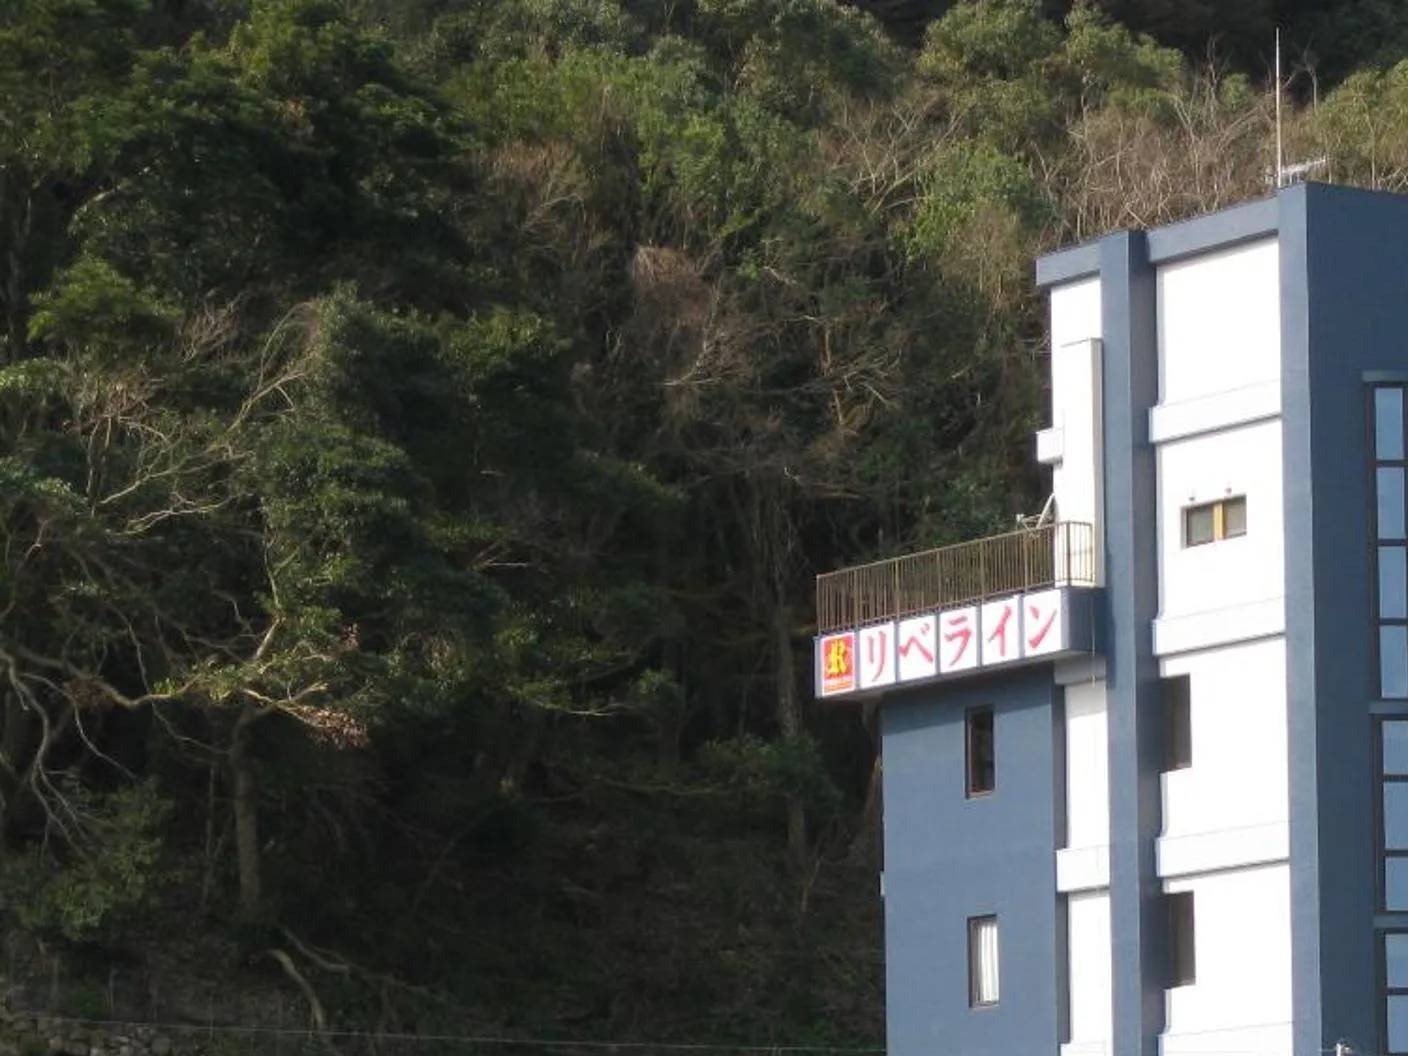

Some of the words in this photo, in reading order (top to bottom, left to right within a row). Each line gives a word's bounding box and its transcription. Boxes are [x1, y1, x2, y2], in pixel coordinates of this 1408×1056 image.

[868, 605, 1058, 682] リベライン
